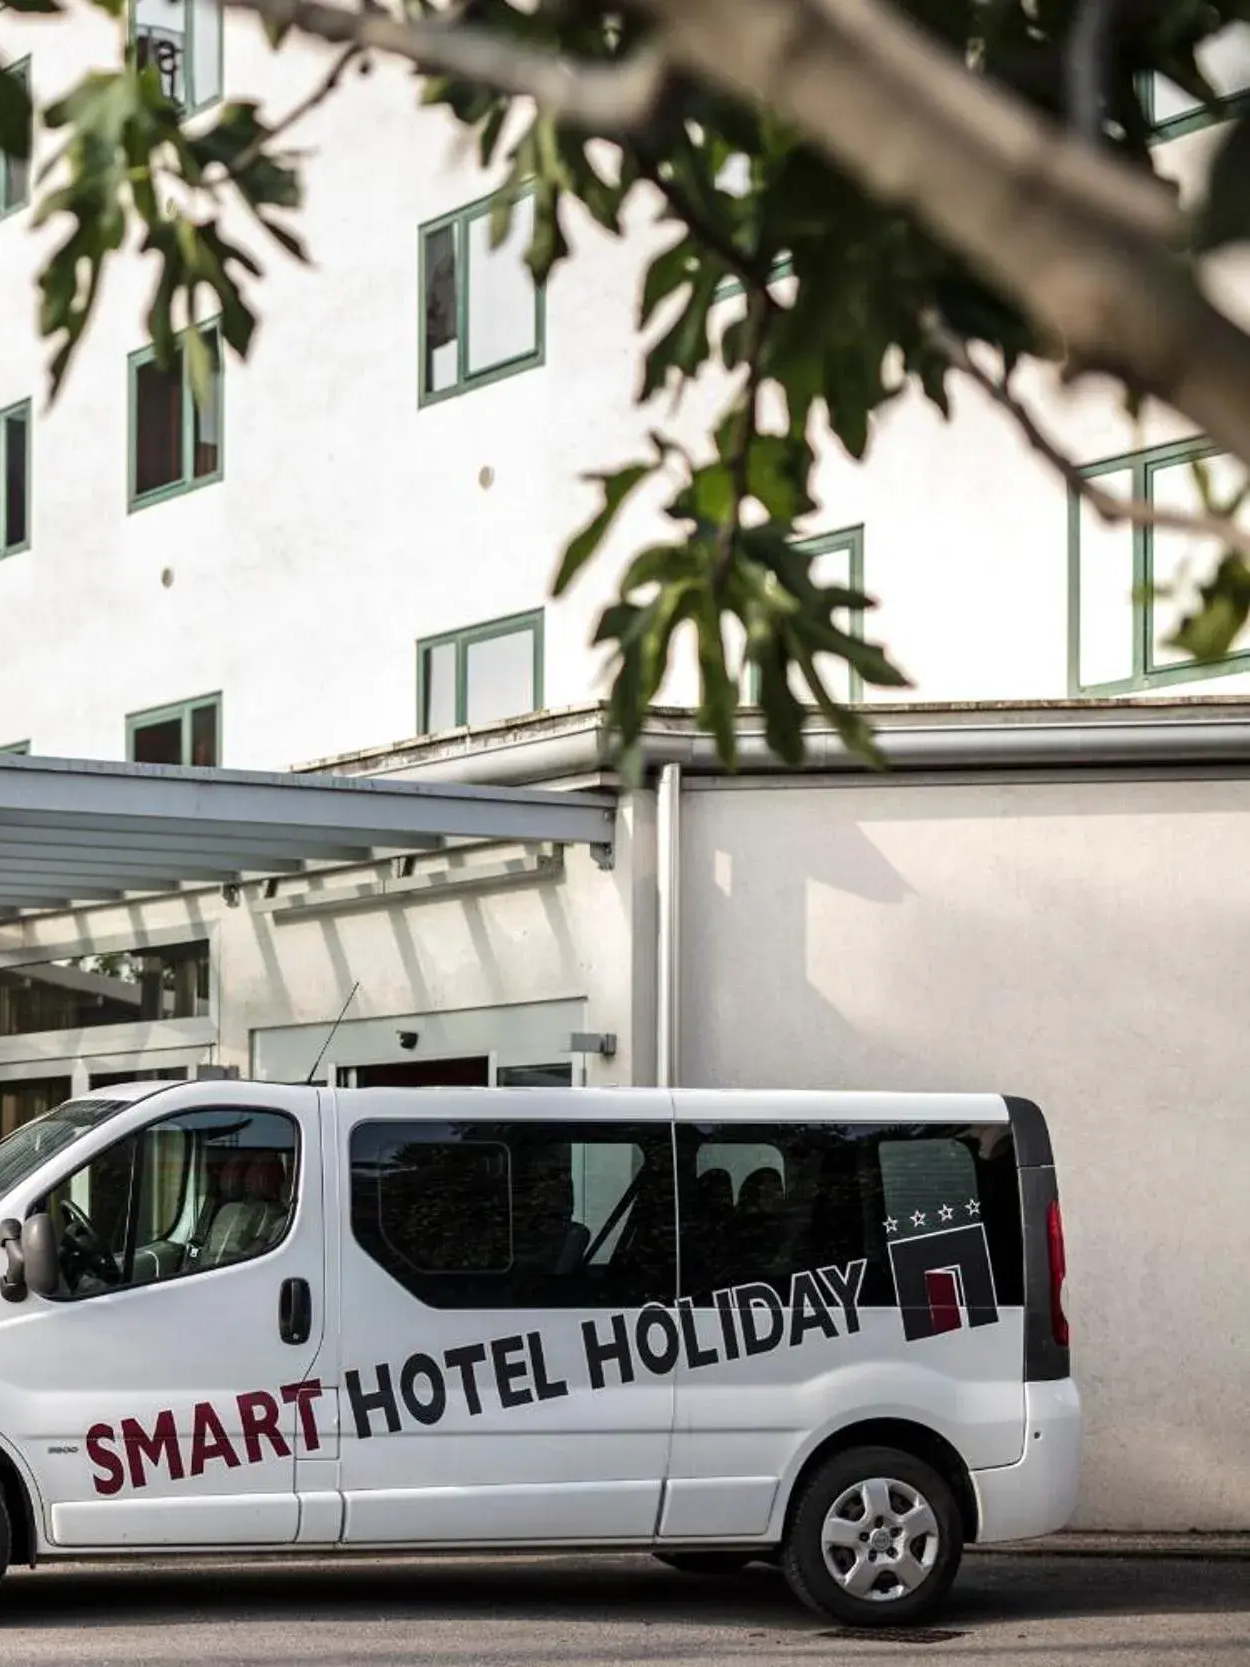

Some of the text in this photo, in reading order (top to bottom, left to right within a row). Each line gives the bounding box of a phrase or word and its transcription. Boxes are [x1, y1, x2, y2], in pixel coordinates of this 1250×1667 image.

[86, 1258, 868, 1495] SMART HOTEL HOLIDAY
